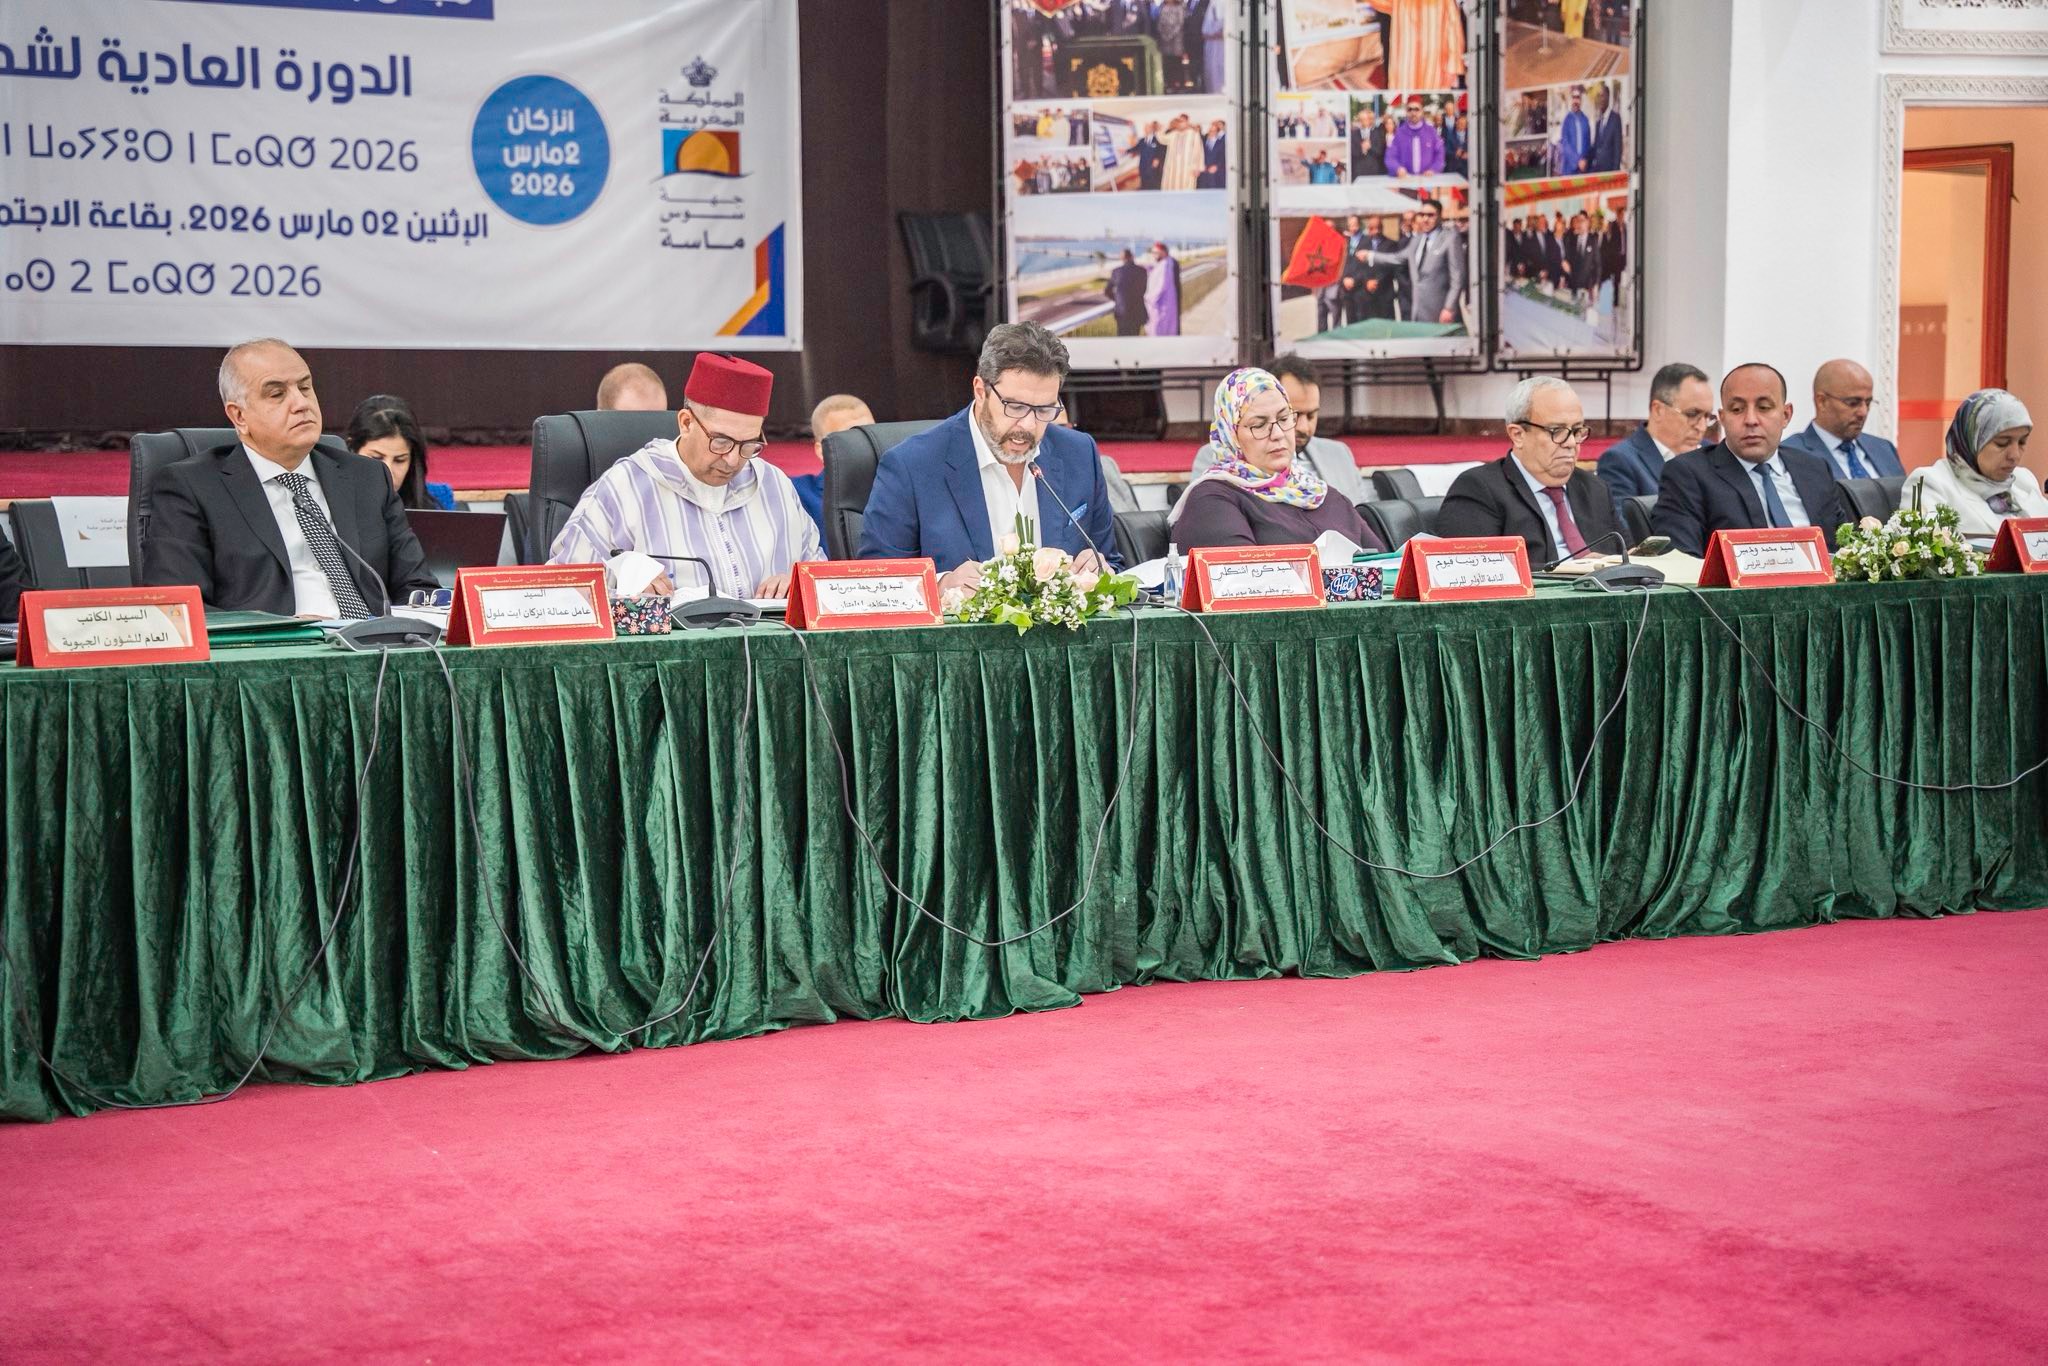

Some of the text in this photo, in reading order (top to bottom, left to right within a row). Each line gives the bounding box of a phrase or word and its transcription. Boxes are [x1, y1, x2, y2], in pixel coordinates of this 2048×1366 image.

[97, 37, 260, 96] العادية
[275, 48, 413, 104] الدورة
[330, 137, 419, 172] 2026
[510, 171, 576, 197] 2026
[89, 201, 172, 236] بقاعة
[280, 208, 354, 242] مارس
[362, 210, 399, 235] 02
[407, 212, 489, 246] الإثنين
[70, 259, 93, 293] 2
[230, 264, 322, 297] 2026
[524, 589, 547, 599] السيد
[77, 609, 147, 625] السيد الكاتب
[547, 607, 569, 616] عمالة
[572, 607, 591, 617] عامل
[62, 636, 100, 651] الجهوية
[145, 632, 169, 646] العام
